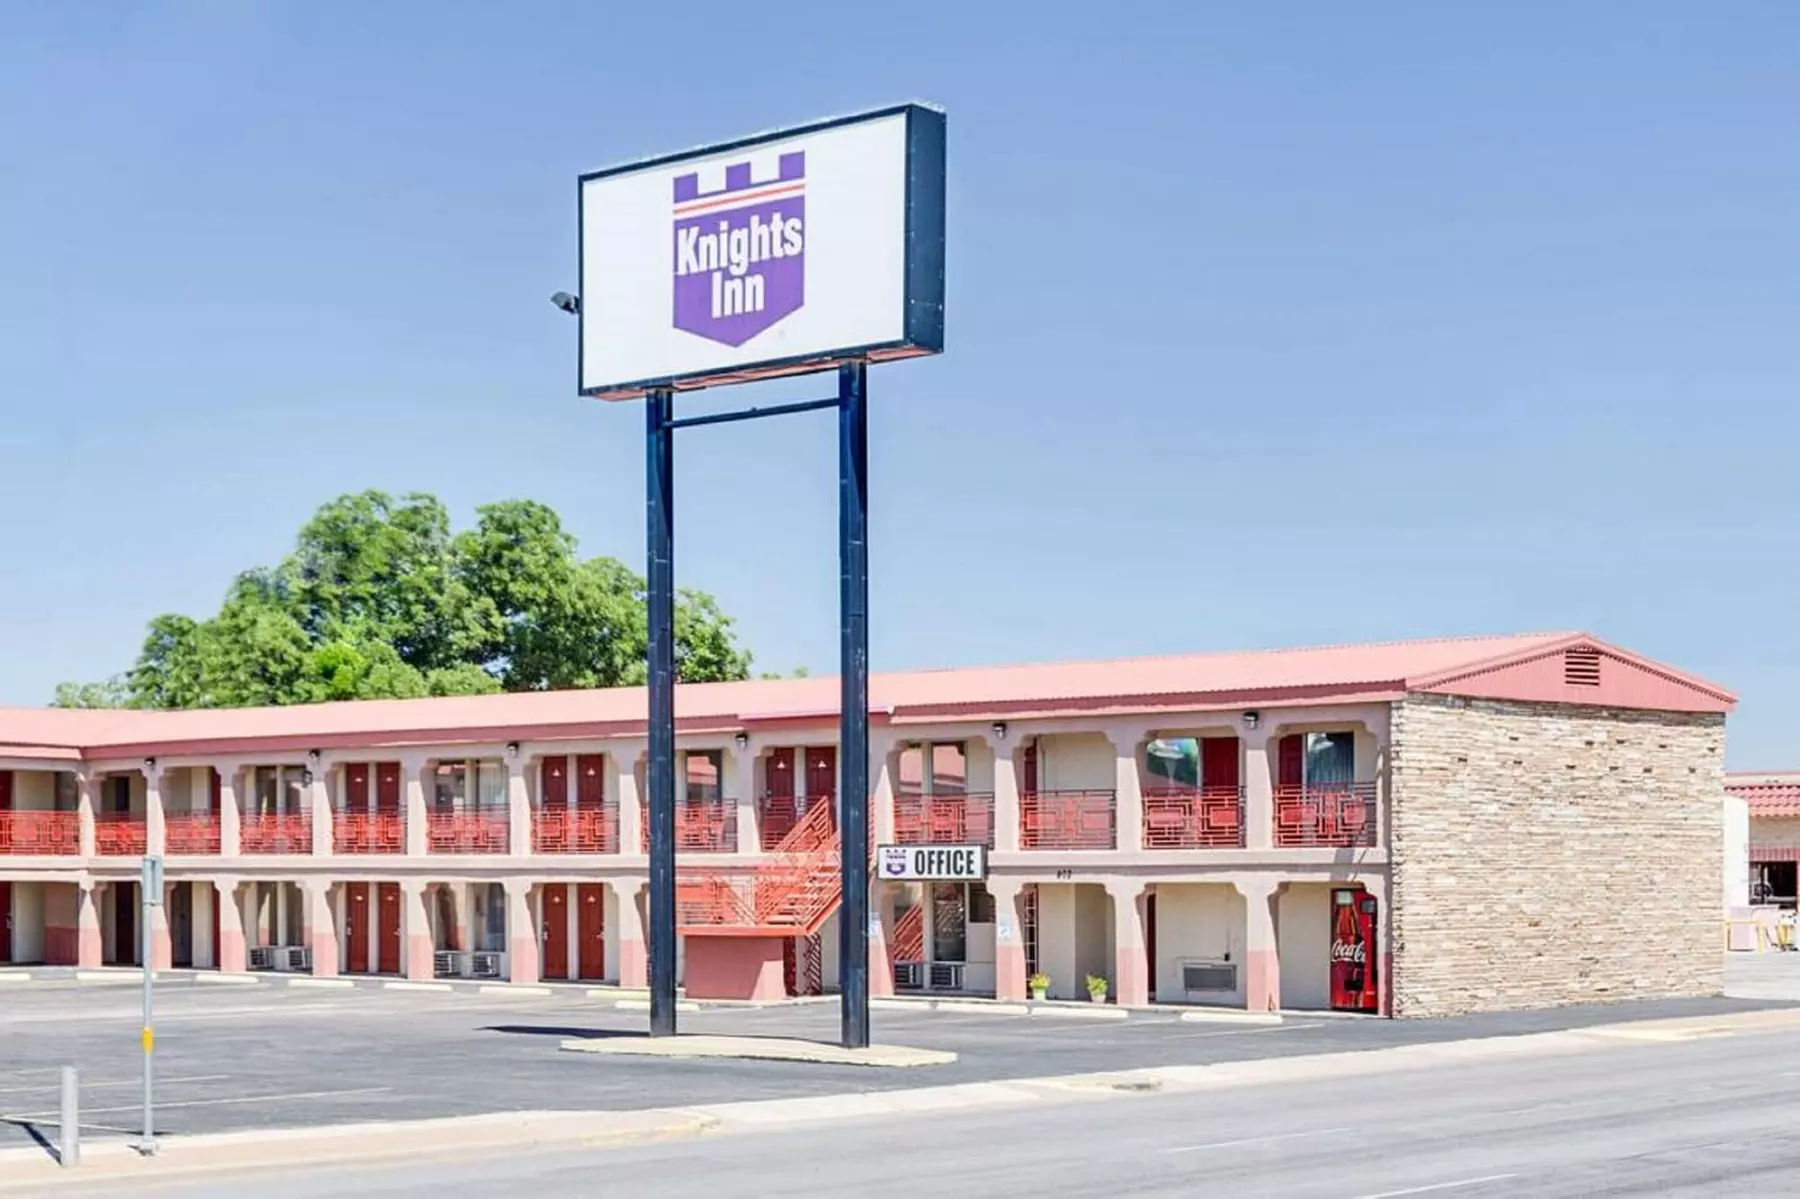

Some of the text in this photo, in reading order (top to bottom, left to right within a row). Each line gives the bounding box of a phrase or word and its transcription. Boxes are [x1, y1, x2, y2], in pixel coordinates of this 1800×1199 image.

[676, 211, 803, 277] Knights
[711, 271, 765, 319] Inn
[914, 849, 975, 875] OFFICE
